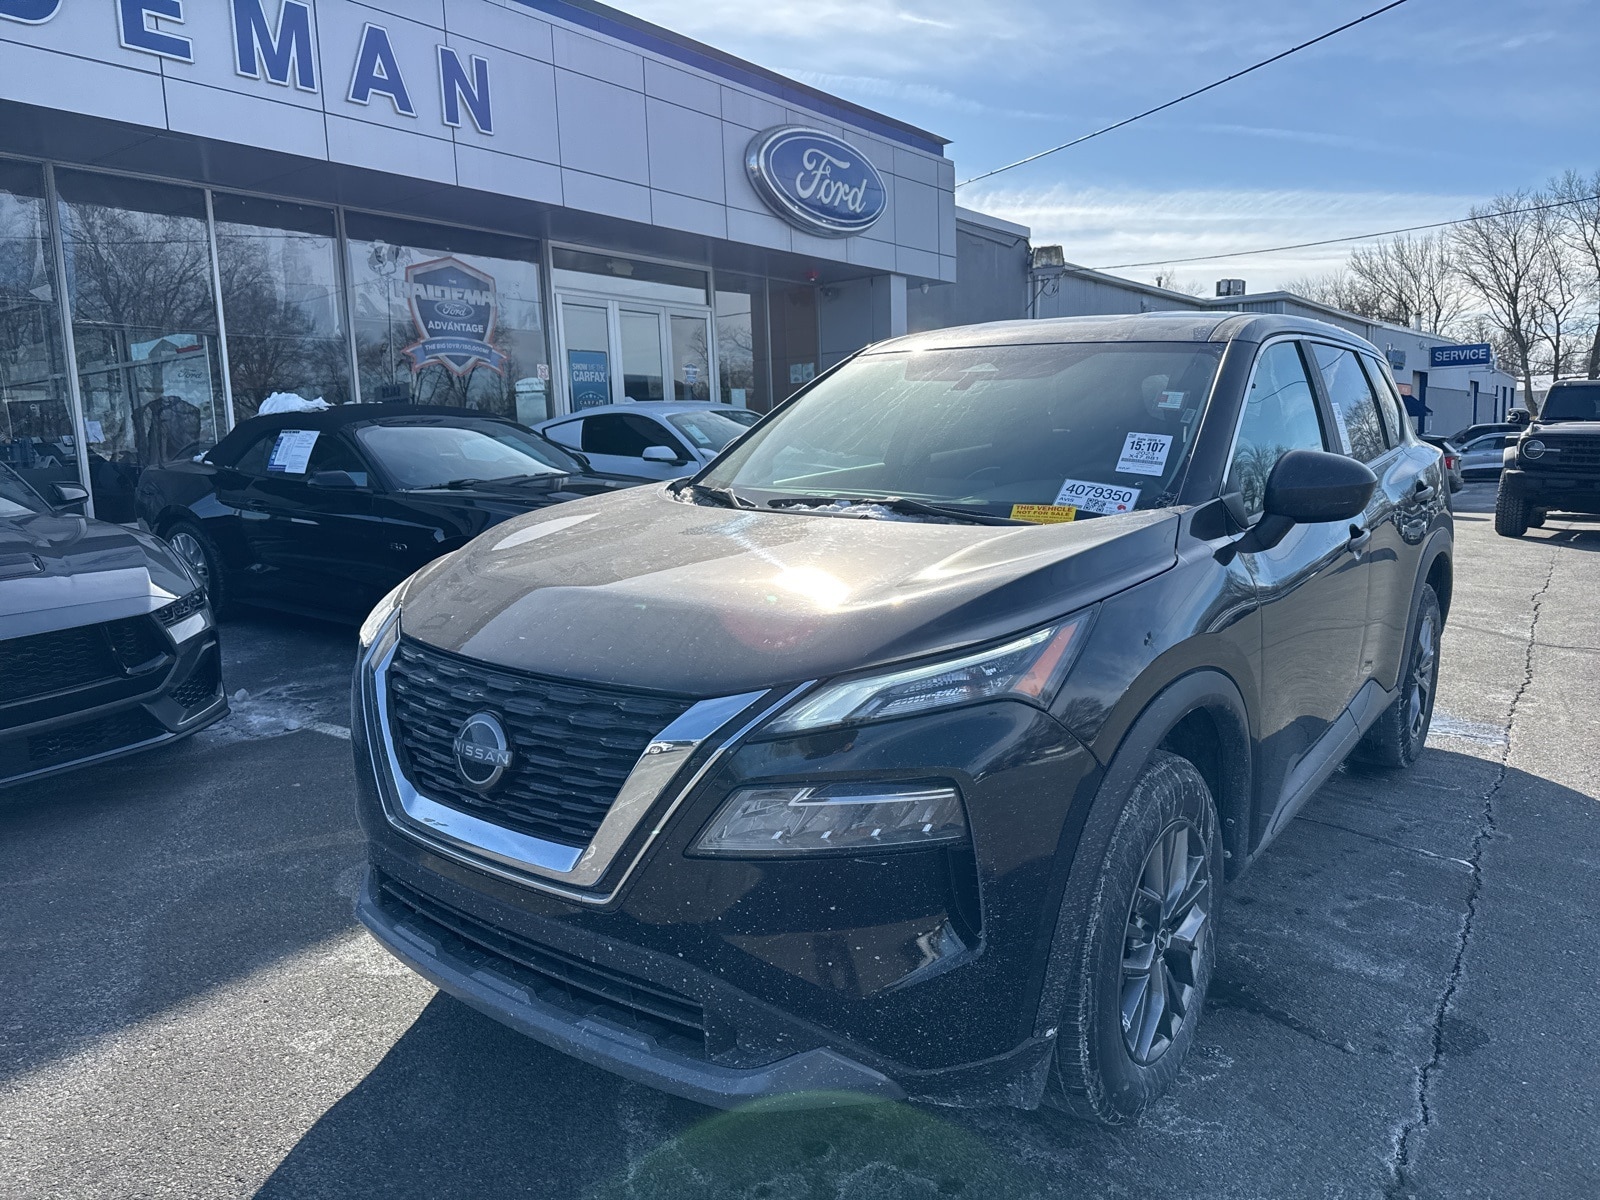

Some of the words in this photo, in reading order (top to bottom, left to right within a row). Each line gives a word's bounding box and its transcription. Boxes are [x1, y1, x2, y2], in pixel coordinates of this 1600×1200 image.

[0, 0, 494, 136] EMAN
[795, 148, 868, 213] Ford
[442, 304, 467, 316] Ford
[427, 320, 485, 333] ADVANTAGE
[424, 343, 436, 351] THE
[1434, 348, 1487, 362] SERVICE
[177, 368, 203, 379] Ford
[572, 370, 606, 383] CARFAX
[1130, 440, 1166, 453] 15:107
[1065, 483, 1133, 503] 4079350
[453, 739, 509, 765] NISSAN
